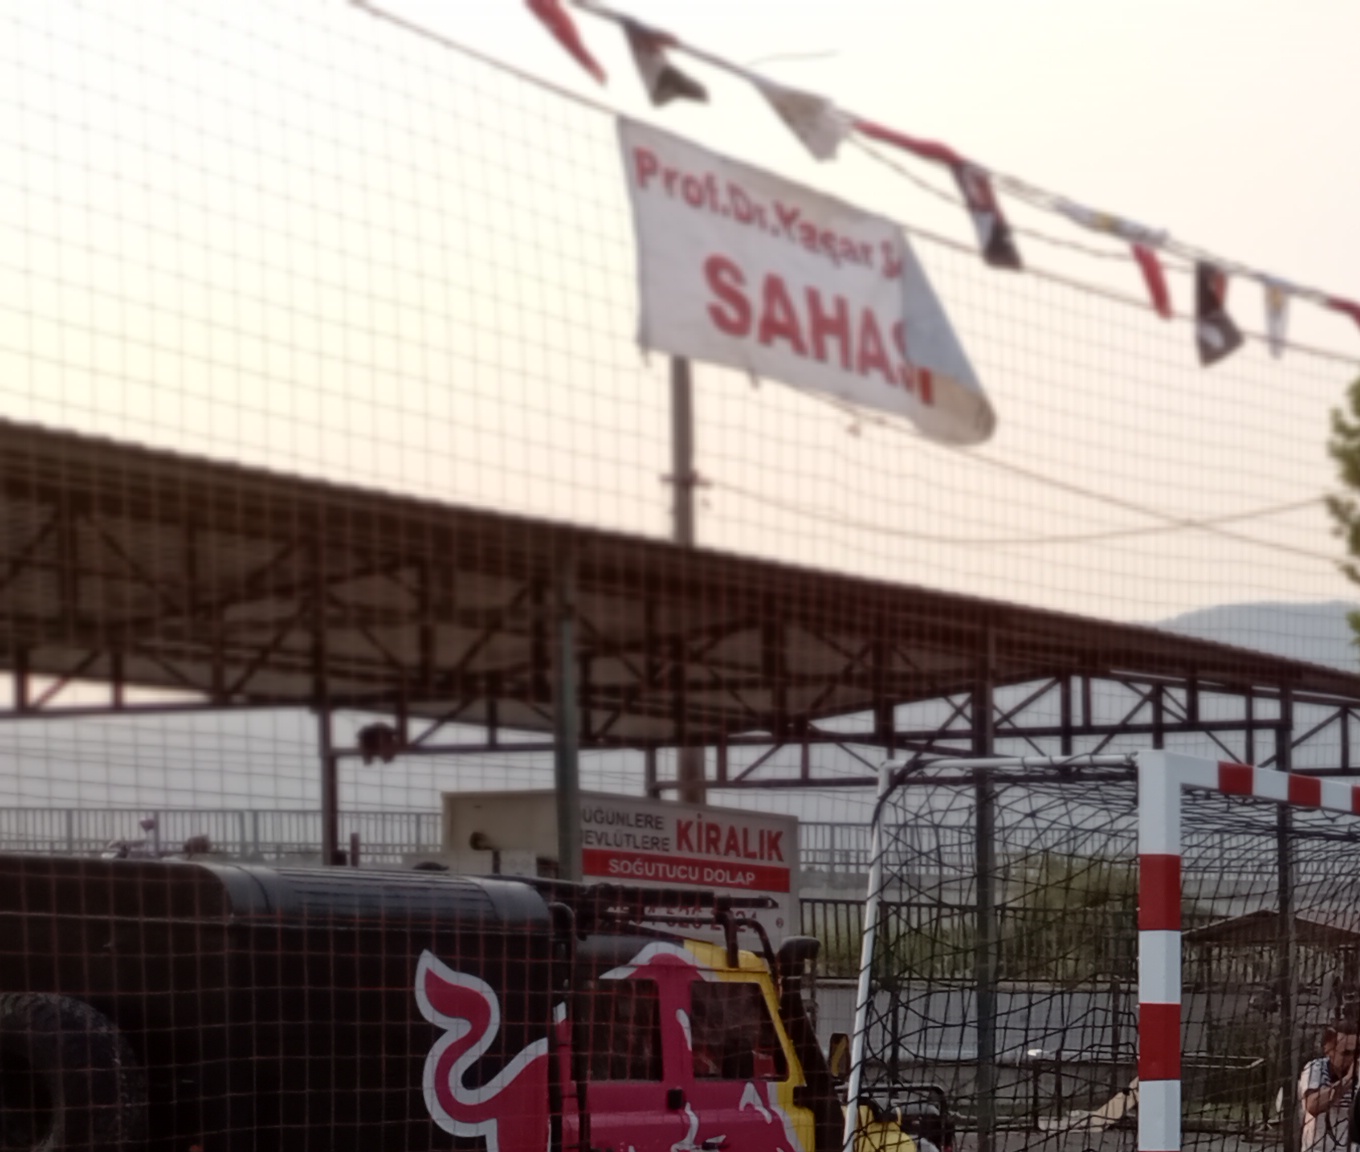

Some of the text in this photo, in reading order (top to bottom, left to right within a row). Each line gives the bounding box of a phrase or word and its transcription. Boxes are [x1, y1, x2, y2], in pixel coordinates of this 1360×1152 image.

[581, 829, 670, 852] EVLÜTLERE
[676, 814, 784, 862] KİRALIK
[608, 858, 756, 885] SOĞUTUCU DOLAP
